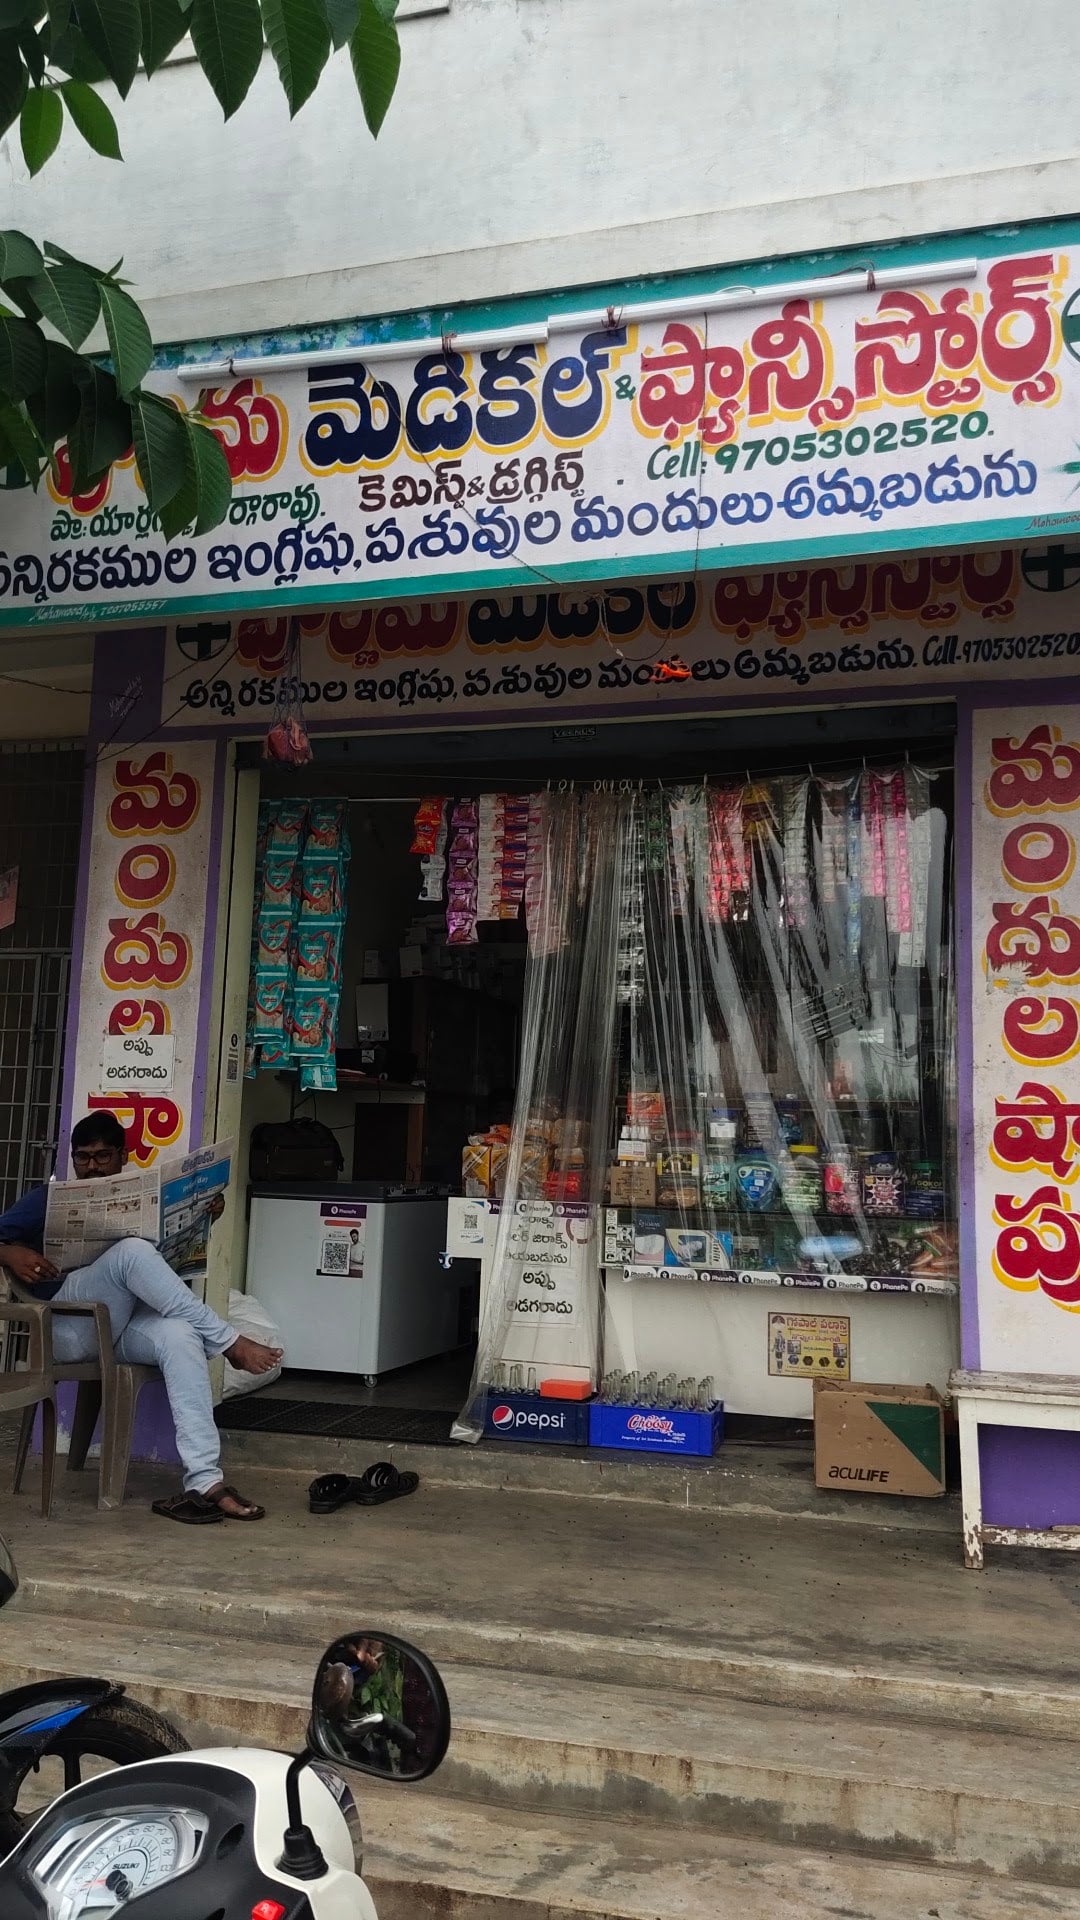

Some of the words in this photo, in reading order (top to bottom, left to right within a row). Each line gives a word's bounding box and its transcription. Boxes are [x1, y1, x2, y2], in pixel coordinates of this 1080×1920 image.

[794, 1278, 821, 1288] PhonePe
[838, 1281, 865, 1290] PhonePe
[881, 1283, 909, 1292] PhonePe
[516, 1410, 565, 1431] pepsi
[112, 1861, 140, 1871] SUZUKI
